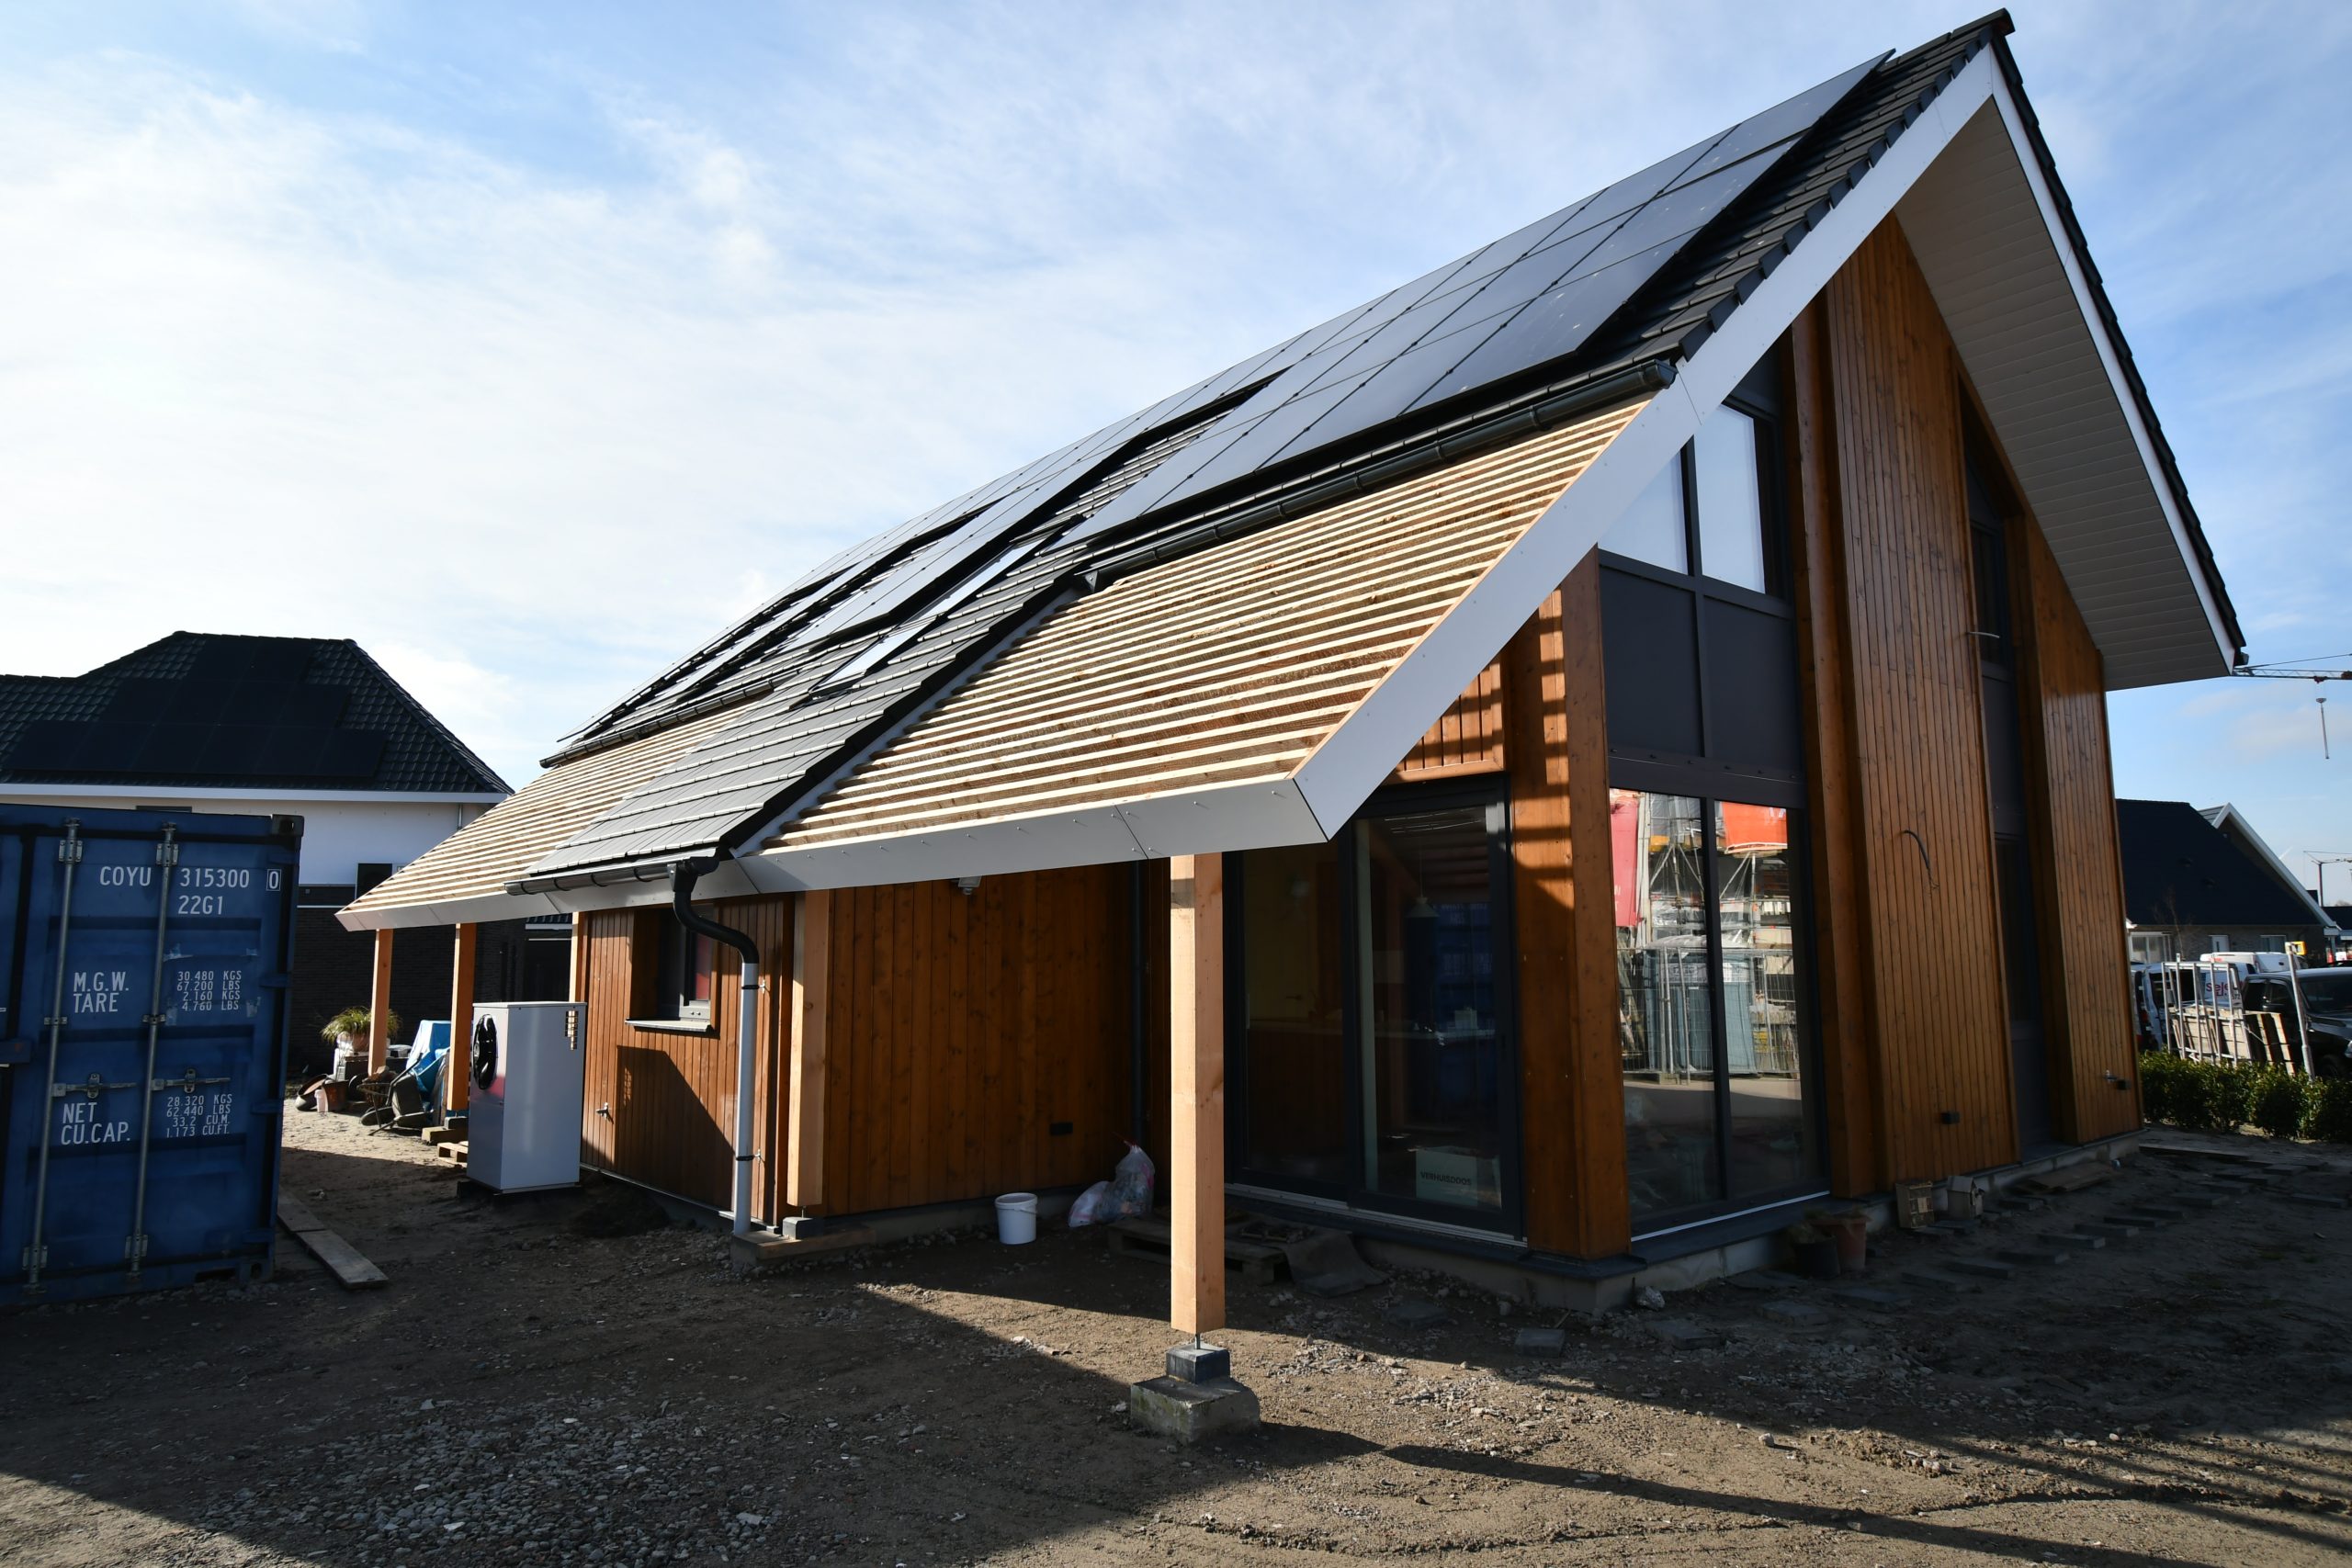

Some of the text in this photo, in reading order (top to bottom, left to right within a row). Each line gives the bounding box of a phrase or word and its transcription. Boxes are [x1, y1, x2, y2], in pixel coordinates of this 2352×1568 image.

[99, 866, 280, 890] COYU 315300 0
[177, 895, 223, 915] 22G1
[73, 971, 130, 992] M.G.W.
[177, 970, 242, 982] 30.480 KGS
[176, 980, 241, 992] 67.200 LBS
[183, 989, 241, 1002] 2.160 KGS
[73, 992, 119, 1013] TARE
[182, 999, 239, 1011] 4.760 LBS
[167, 1094, 232, 1107] 28.320 KGS
[62, 1102, 97, 1124] NET
[166, 1104, 232, 1118] 62.440 LBS
[172, 1116, 197, 1127] 33.2
[61, 1122, 130, 1145] CU.CAP.
[166, 1126, 196, 1138] 1.173
